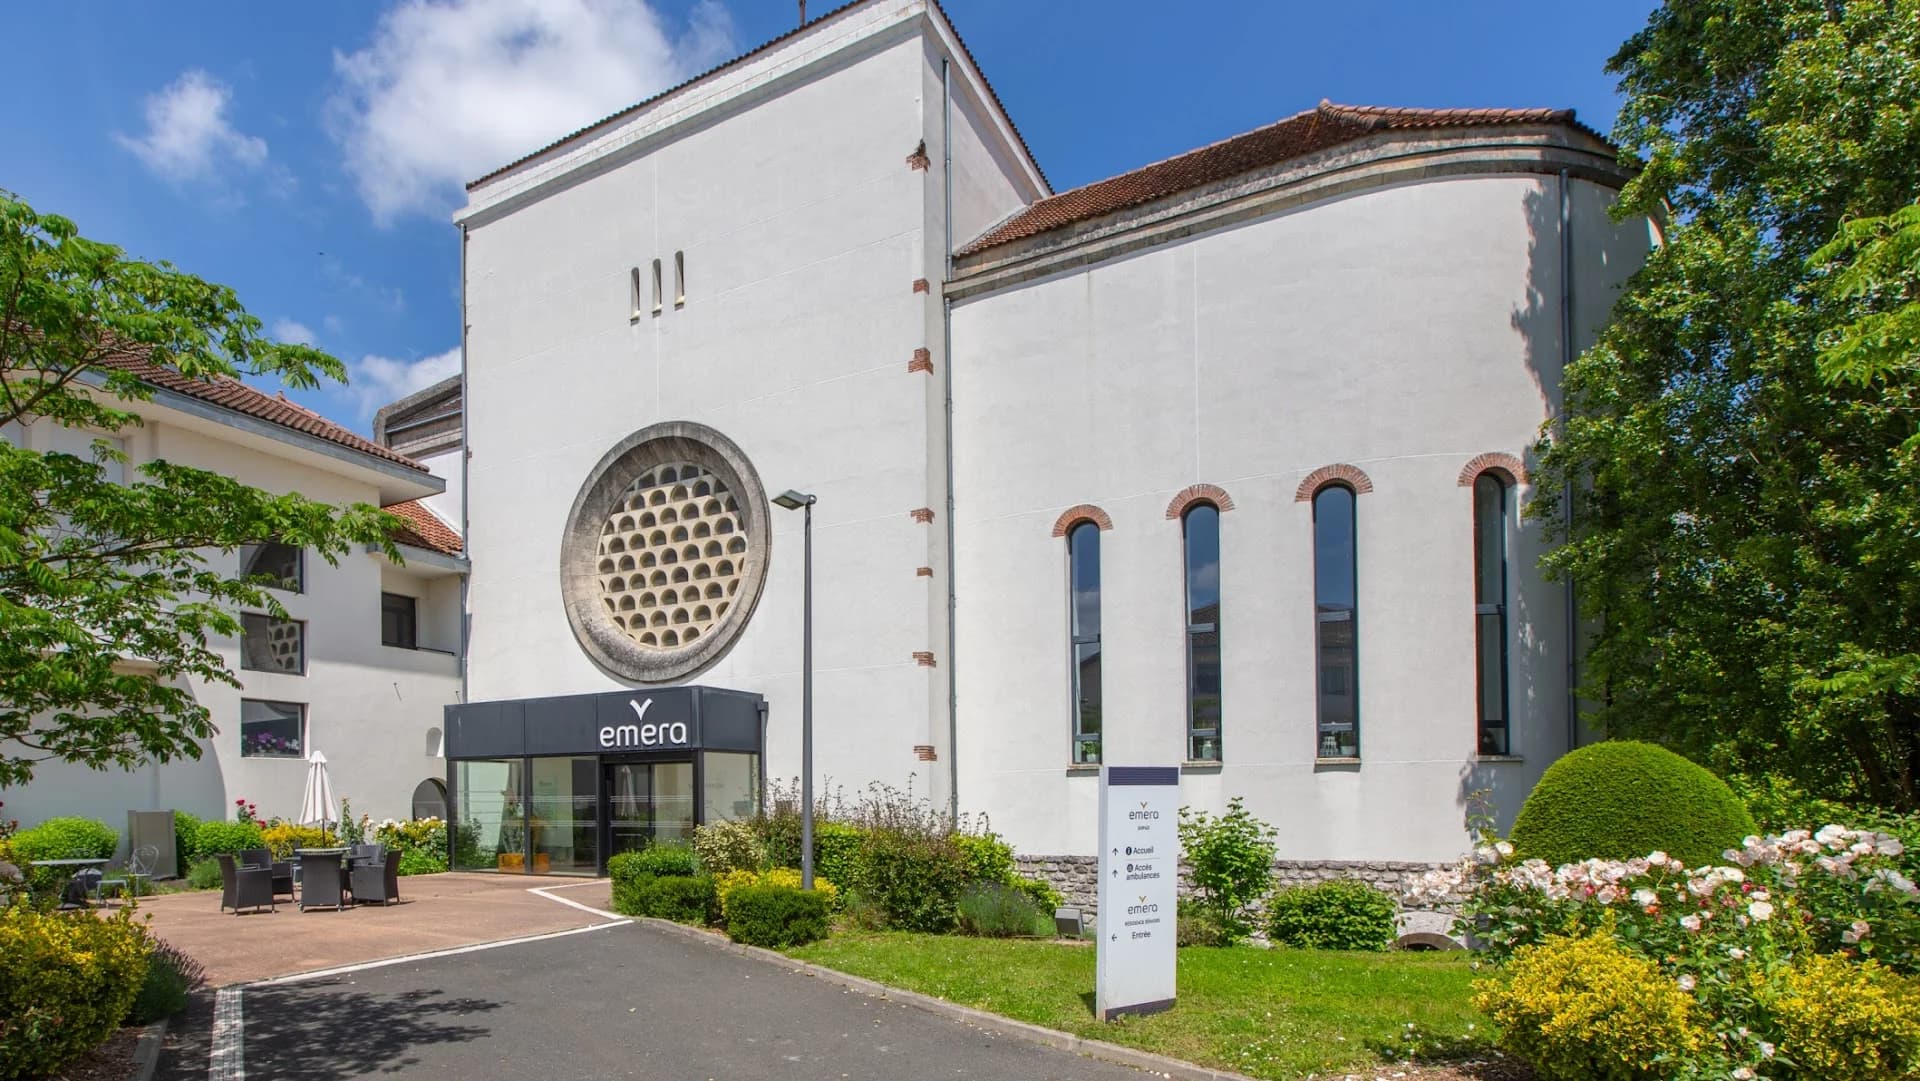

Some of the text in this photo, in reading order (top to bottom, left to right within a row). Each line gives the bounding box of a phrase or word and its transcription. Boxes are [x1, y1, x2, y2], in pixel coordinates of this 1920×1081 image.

[600, 722, 687, 747] emera
[1129, 811, 1159, 820] emera
[1133, 846, 1154, 855] Accueil
[1134, 864, 1152, 872] Accès
[1126, 871, 1160, 881] ambulances
[1128, 904, 1158, 915] emera
[1132, 931, 1151, 940] Entrée
